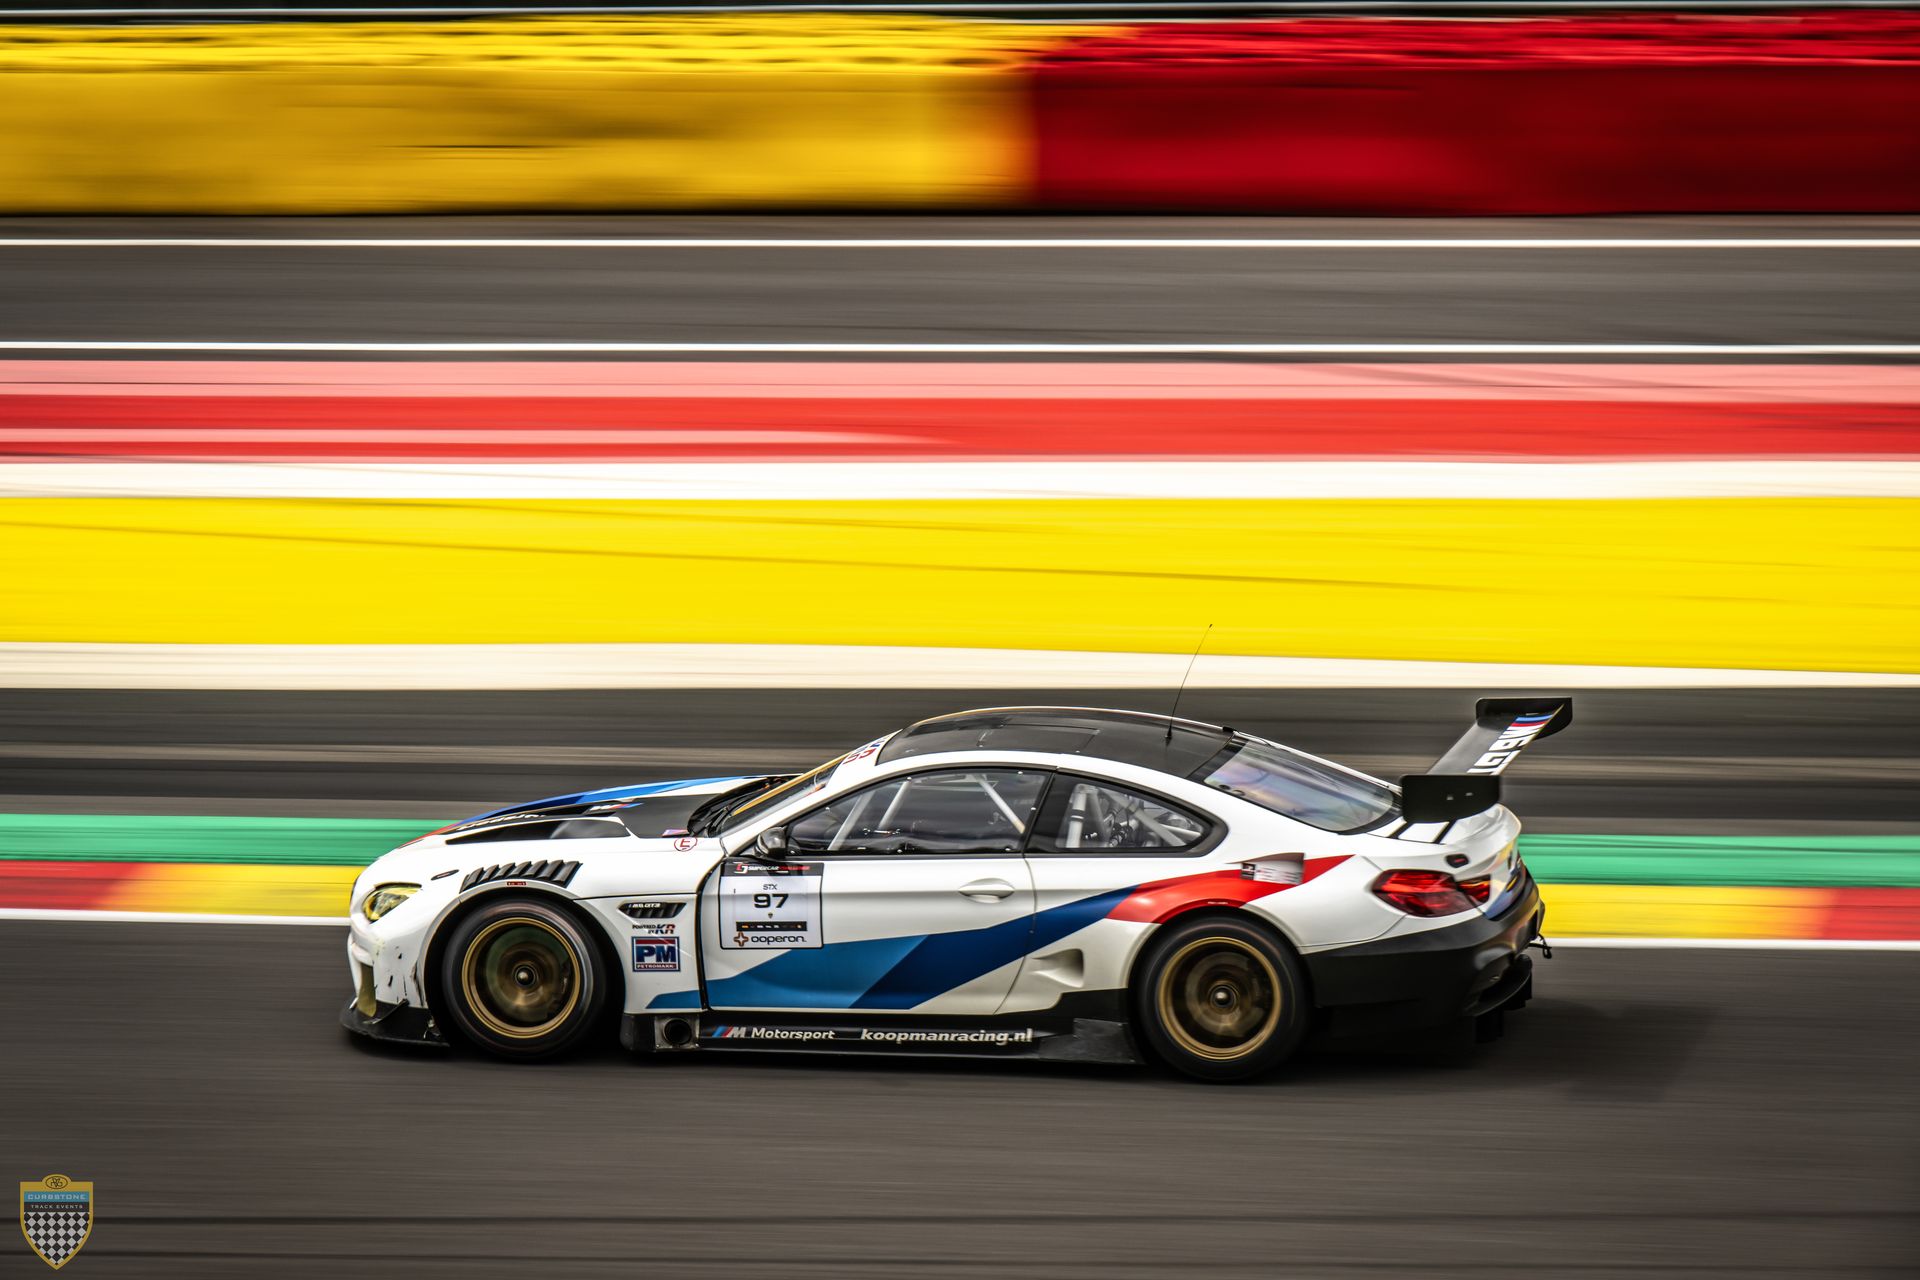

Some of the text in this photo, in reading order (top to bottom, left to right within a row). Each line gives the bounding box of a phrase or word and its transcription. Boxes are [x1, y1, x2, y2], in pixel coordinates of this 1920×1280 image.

[1467, 725, 1546, 776] M6GT
[754, 893, 789, 908] 97
[655, 924, 676, 934] KR
[636, 945, 677, 963] PM
[751, 1027, 835, 1042] Motorsport
[860, 1028, 1033, 1045] koopmanracing.nl
